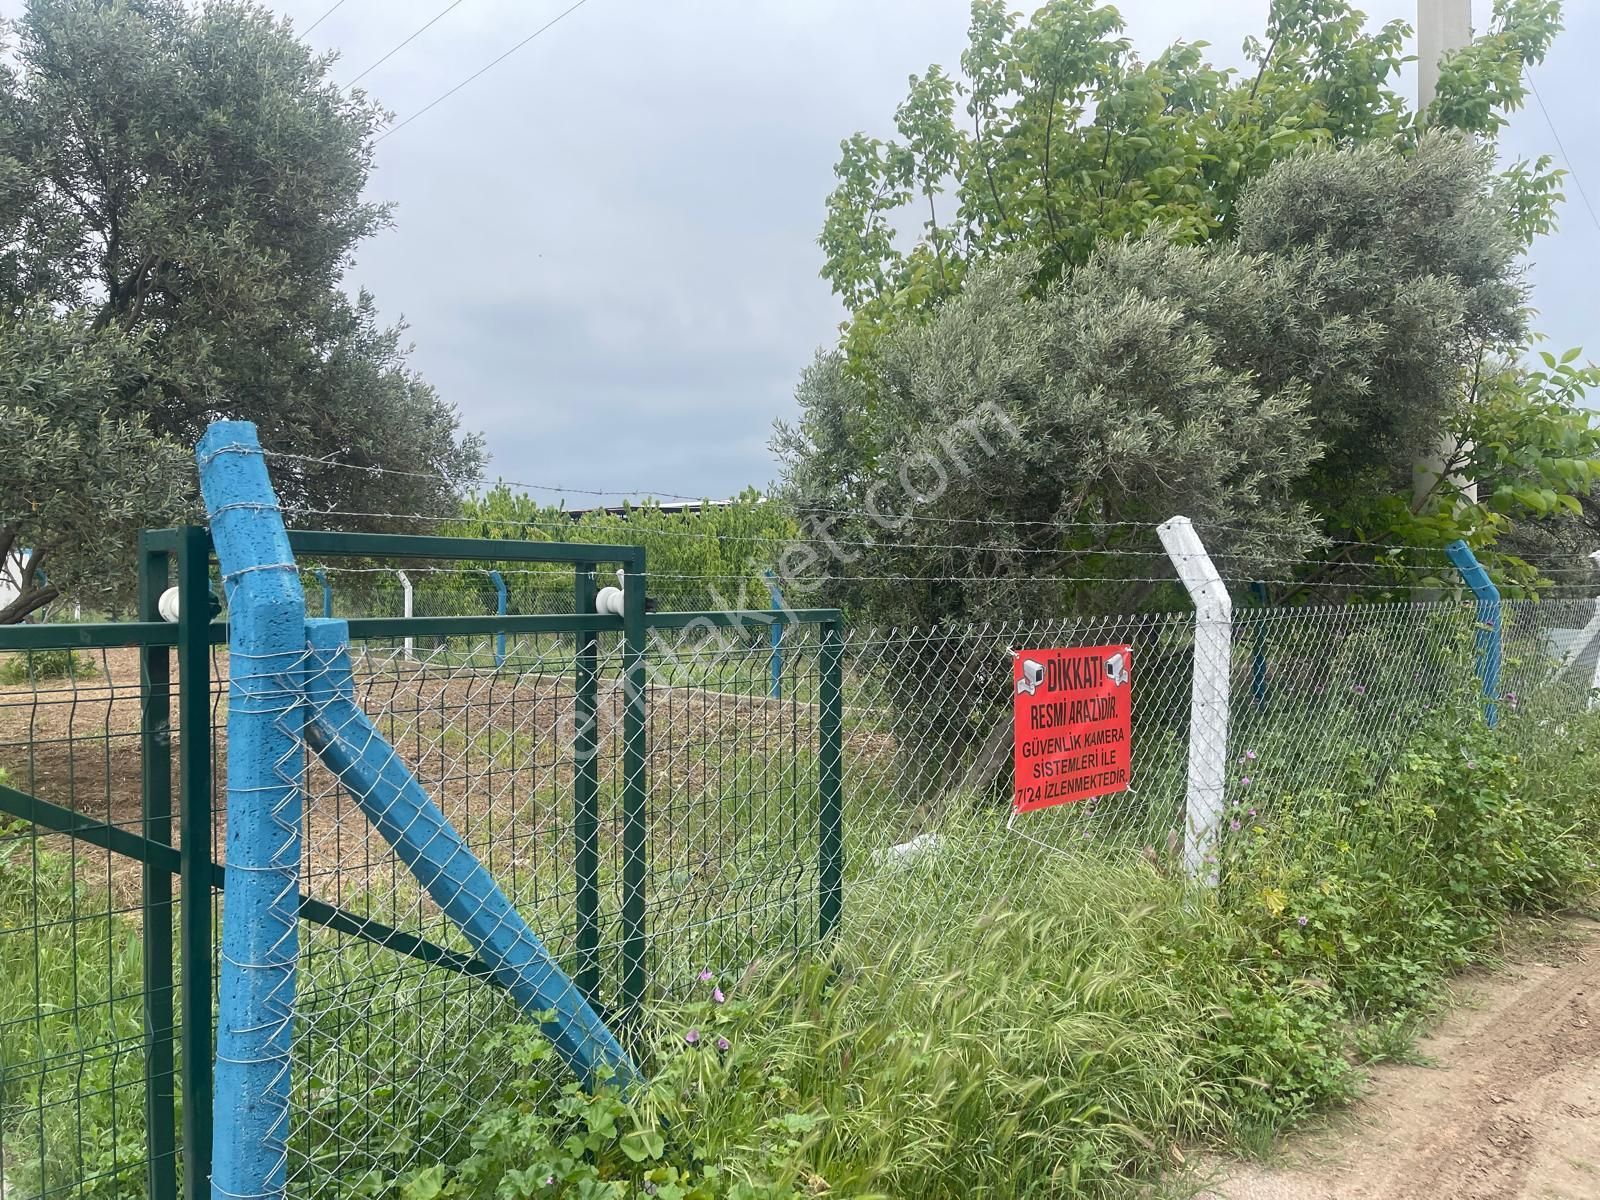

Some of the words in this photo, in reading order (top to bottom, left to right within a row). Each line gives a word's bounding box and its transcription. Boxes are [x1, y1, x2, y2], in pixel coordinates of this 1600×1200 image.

[1047, 652, 1103, 692] DİKKAT!
[1031, 698, 1067, 730] RESMİ
[1022, 732, 1082, 758] GÜVENLİK
[1084, 728, 1125, 748] KAMERA
[1033, 749, 1099, 779] SİSTEMLERİ
[1101, 748, 1117, 766] İLE
[1017, 785, 1041, 804] 7/24
[1044, 767, 1128, 798] İZLENMEKTEDİR.
